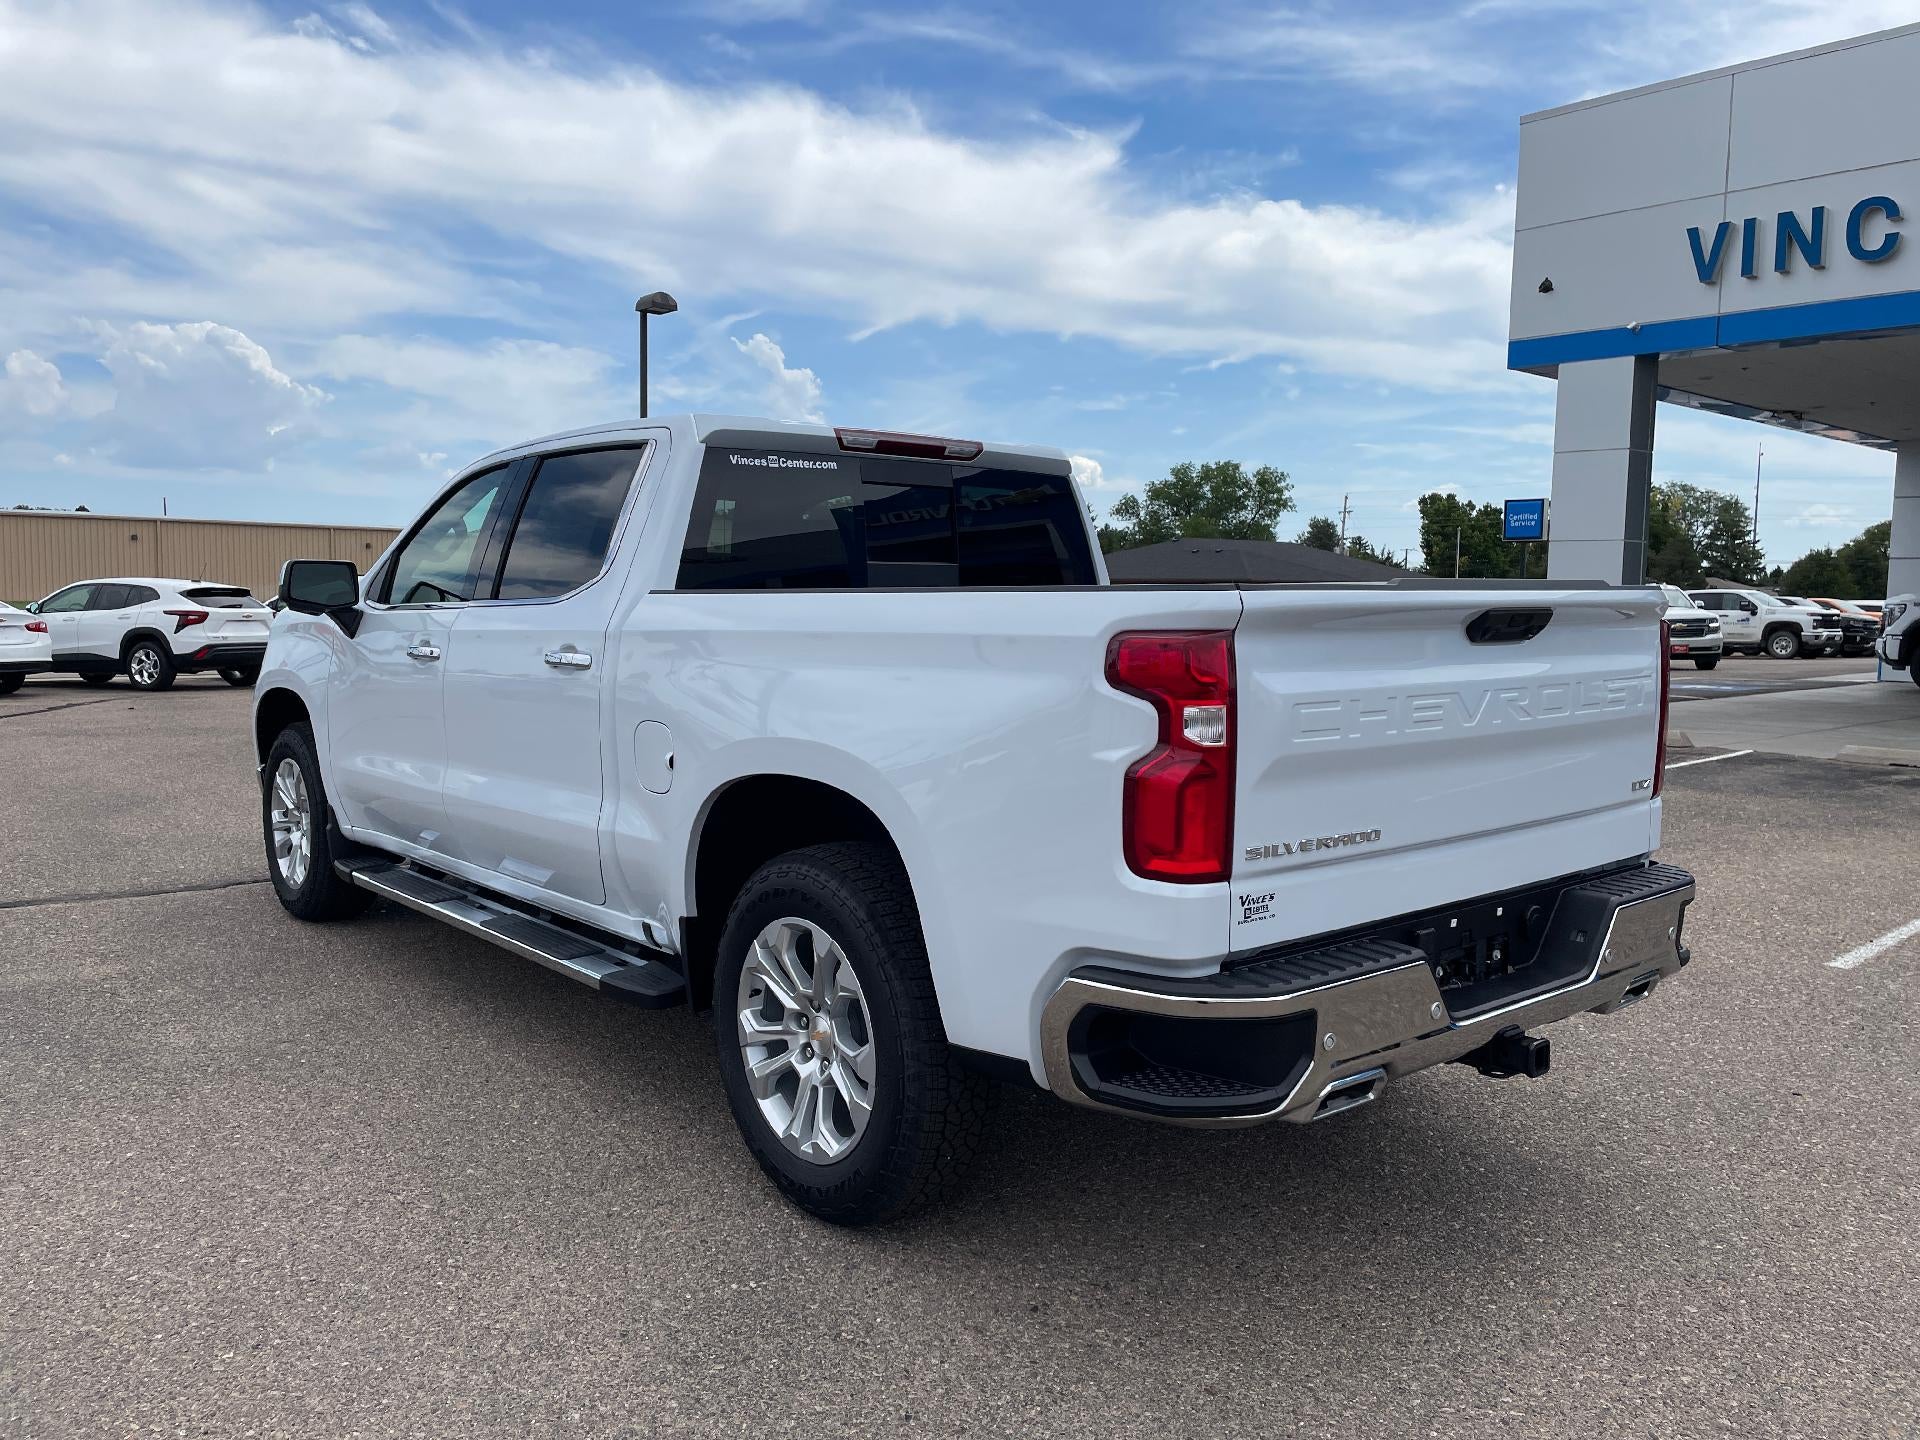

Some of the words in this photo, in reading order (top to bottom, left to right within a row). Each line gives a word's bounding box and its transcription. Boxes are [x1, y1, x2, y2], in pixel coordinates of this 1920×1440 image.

[1687, 195, 1904, 285] VINC
[1508, 513, 1538, 521] Certified
[1292, 673, 1652, 743] CHEVROLET
[1245, 829, 1382, 861] SILVERADO
